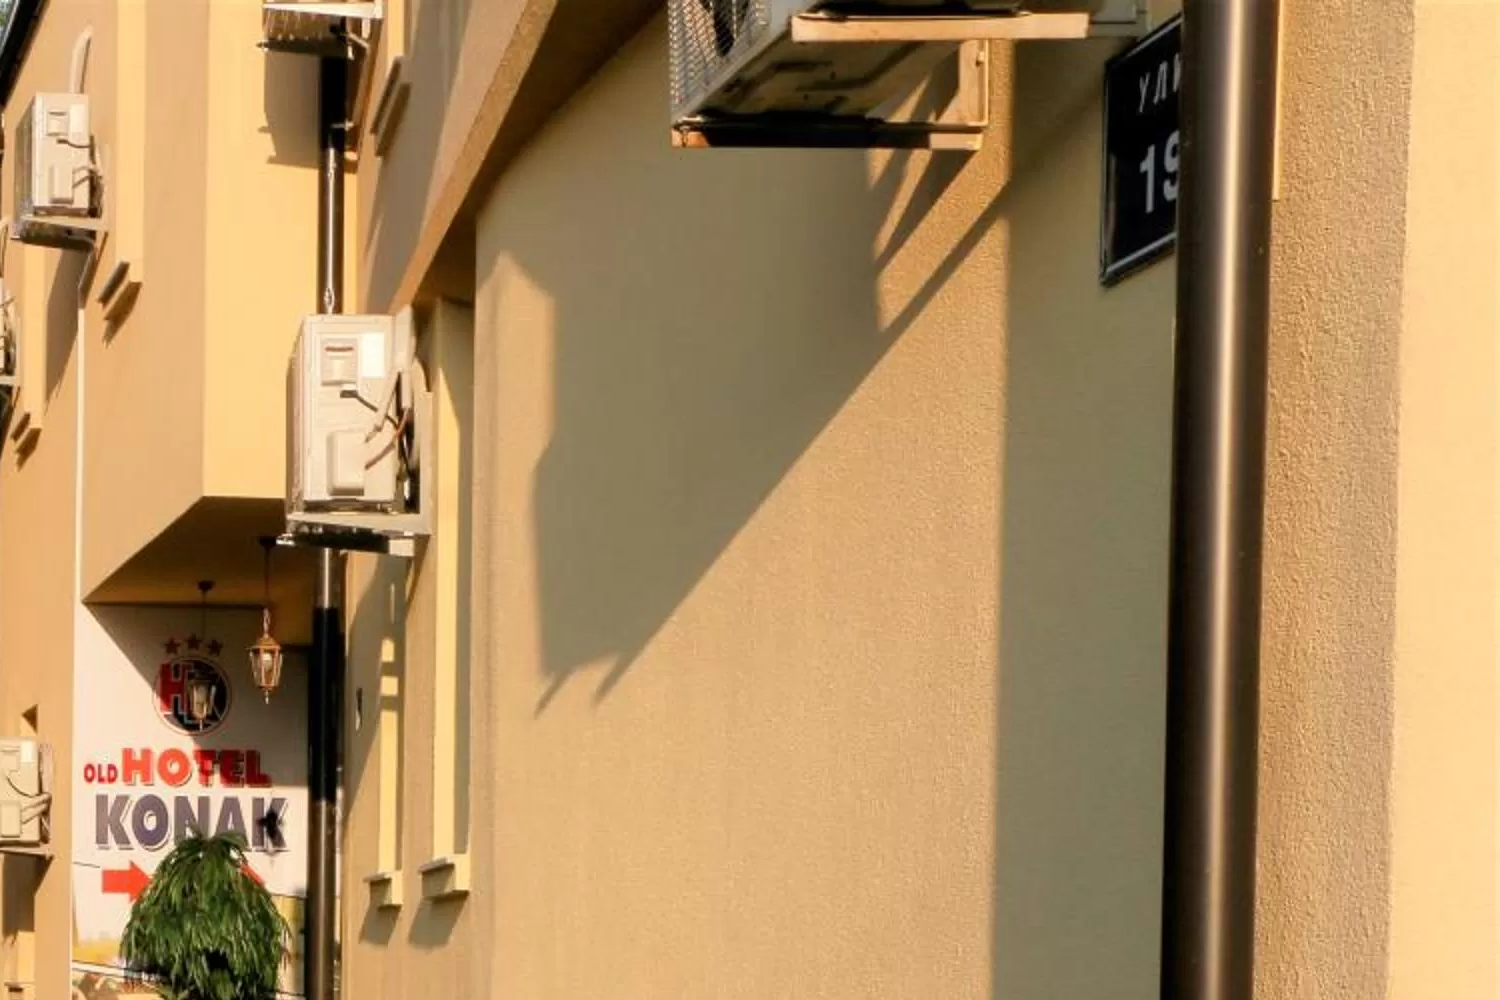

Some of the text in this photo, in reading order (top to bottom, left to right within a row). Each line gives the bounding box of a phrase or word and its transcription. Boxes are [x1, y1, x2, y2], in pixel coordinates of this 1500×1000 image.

[83, 748, 273, 788] OLD HOTEL
[95, 794, 290, 852] KONAK
